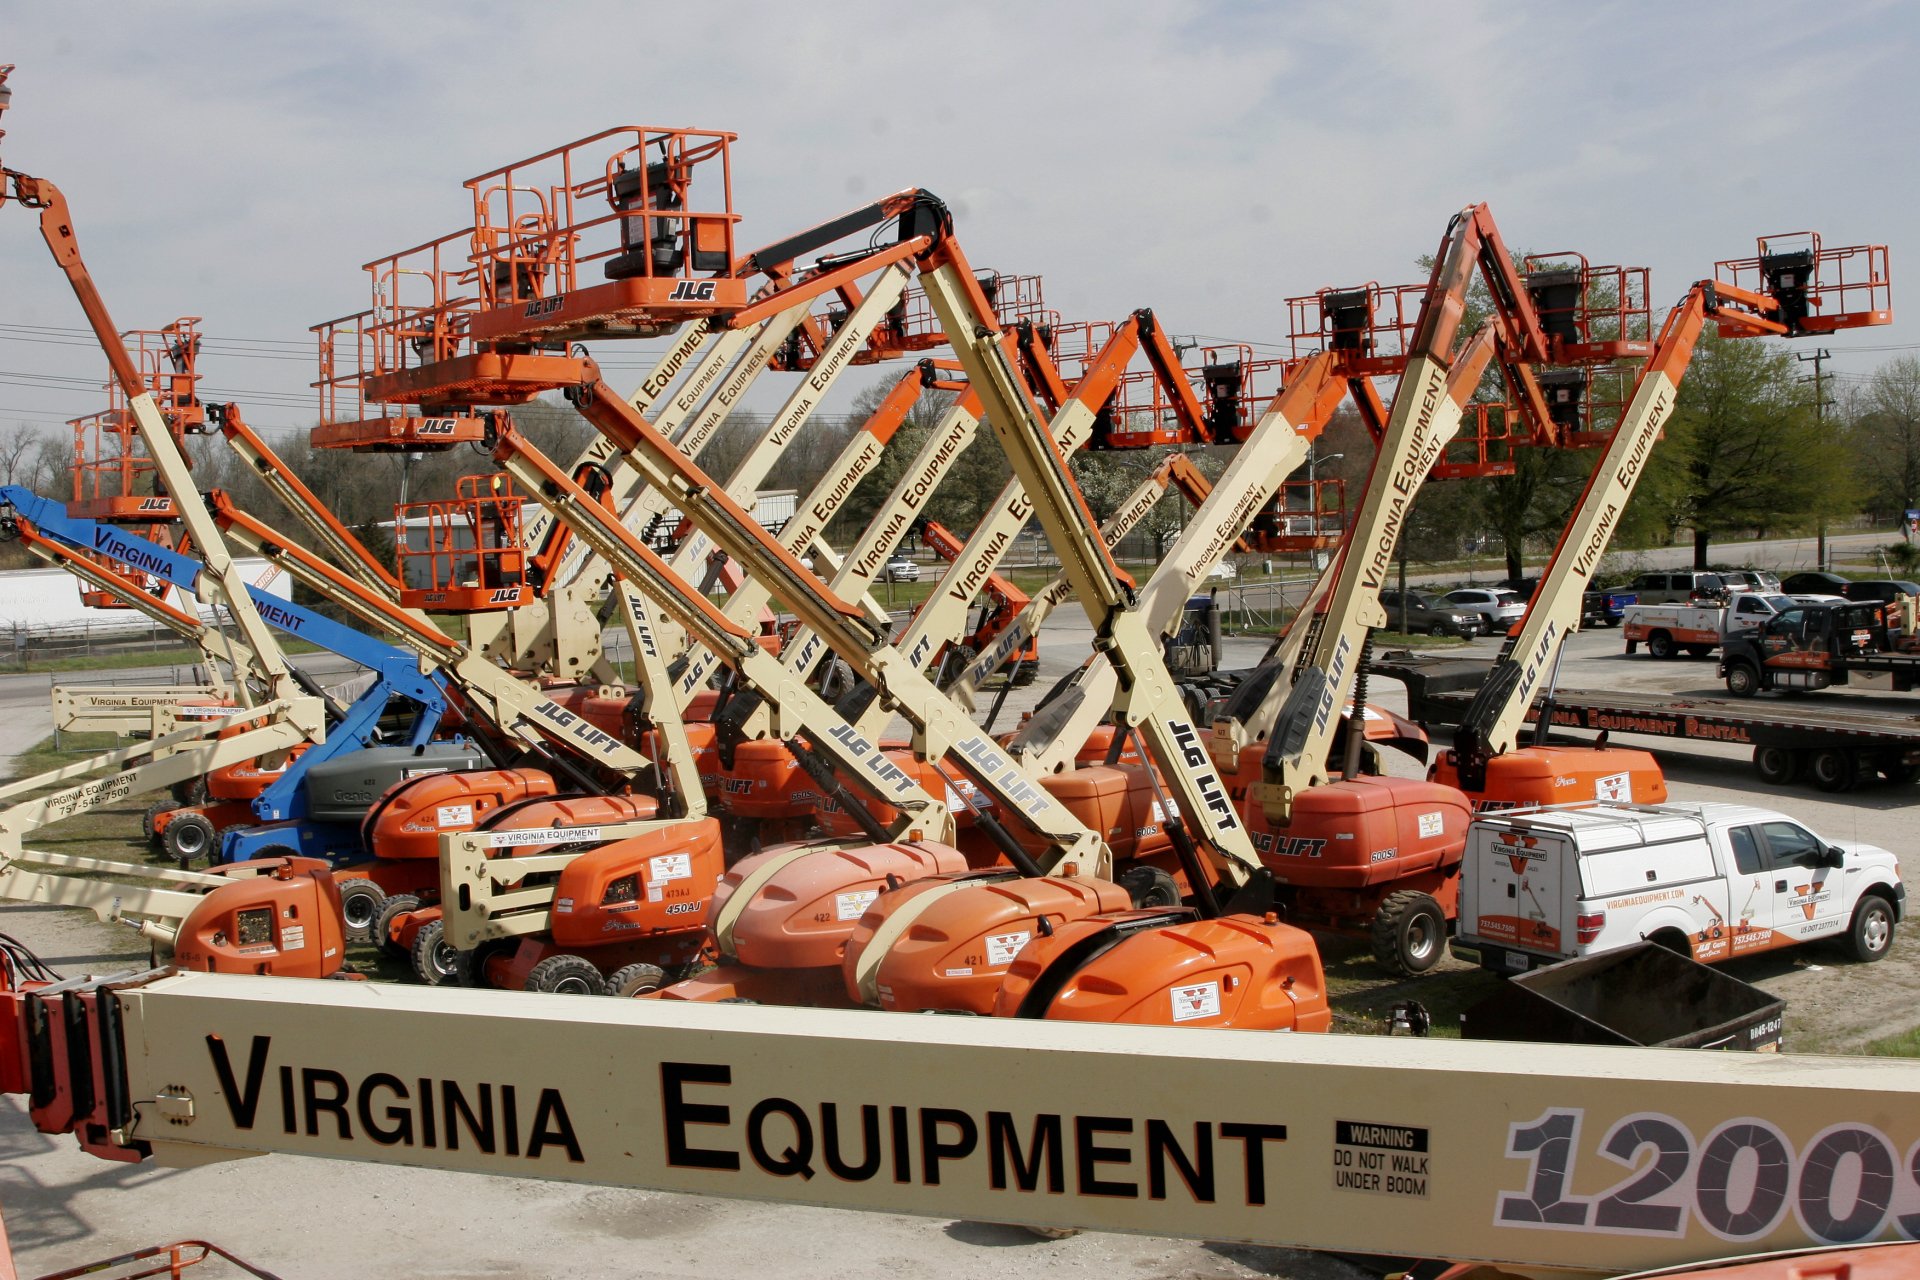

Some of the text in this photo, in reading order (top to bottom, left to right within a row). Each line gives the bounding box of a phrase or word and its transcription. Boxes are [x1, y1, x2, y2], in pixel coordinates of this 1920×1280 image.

[668, 281, 717, 301] JLG
[524, 296, 565, 318] JLG LIFT
[642, 318, 709, 400] EQUIPMENT
[677, 354, 726, 412] EQUIPMENT
[770, 327, 861, 447] VIRGINIA EQUIPMENT
[680, 345, 768, 457] VIRGINIA EQUIPMENT
[417, 419, 457, 434] JLG
[1361, 369, 1442, 589] VIRGINIA EQUIPMENT
[1573, 390, 1667, 578] VIRGINIA EQUIPMENT
[138, 498, 171, 511] JLG
[787, 443, 876, 558] GINIA EQUIPMENT
[852, 421, 966, 580] VIRGINIA EQUIPMENT
[529, 515, 548, 541] LIFT
[1105, 488, 1156, 547] QUIPMENT
[1186, 537, 1221, 579] VIRGINIA
[1216, 482, 1257, 537] EQUIPMENT
[94, 527, 305, 631] VIRGINIA MENT
[949, 531, 1009, 602] VIRGINIA
[490, 588, 520, 603] JLG
[629, 594, 657, 658] JLG LIFT
[795, 633, 821, 673] LIFT
[909, 634, 932, 669] IFT
[972, 625, 1022, 685] JLG LIFT
[1519, 620, 1558, 704] JLG LIFT
[682, 665, 704, 694] JLG
[1315, 633, 1351, 737] JLG LIFT
[91, 697, 178, 706] VIRGINIA EQUIPMENT
[534, 702, 577, 728] JLG
[573, 722, 623, 754] LIFT
[1587, 710, 1677, 735] EQUIPMENT
[1685, 718, 1750, 742] RENTAL
[828, 722, 917, 795] JLG LIFT
[44, 773, 138, 808] VIRGINIA EQUIPMENT
[725, 778, 755, 794] LIFT
[956, 736, 1051, 820] JLG LIFT
[1167, 720, 1238, 833] JLG LIFT
[59, 786, 130, 815] 757-545-7500
[333, 789, 372, 802] Genie
[421, 815, 435, 823] 424
[1136, 826, 1157, 837] 600S
[508, 828, 599, 841] VIRGINIA EQUIPMENT
[1274, 836, 1327, 857] LIFT
[1370, 847, 1397, 863] 600SJ
[1493, 844, 1547, 860] VIRGINIA EQUIPMENT
[666, 888, 690, 898] 473AJ
[1606, 889, 1685, 910] VIRGINIAEQUIPMENT.COM
[666, 901, 701, 915] 450AJ
[814, 912, 831, 923] 422
[1480, 920, 1516, 932] 757.545.7500
[1734, 930, 1772, 945] 757.545.7500
[964, 955, 983, 966] 421
[206, 1033, 1287, 1207] VIRGINIA EQUIPMENT
[1351, 1125, 1414, 1148] WARNING
[1334, 1149, 1429, 1175] DO NOT WALK
[1493, 1106, 1920, 1246] 1200
[1336, 1171, 1426, 1196] UNDER BOOM
